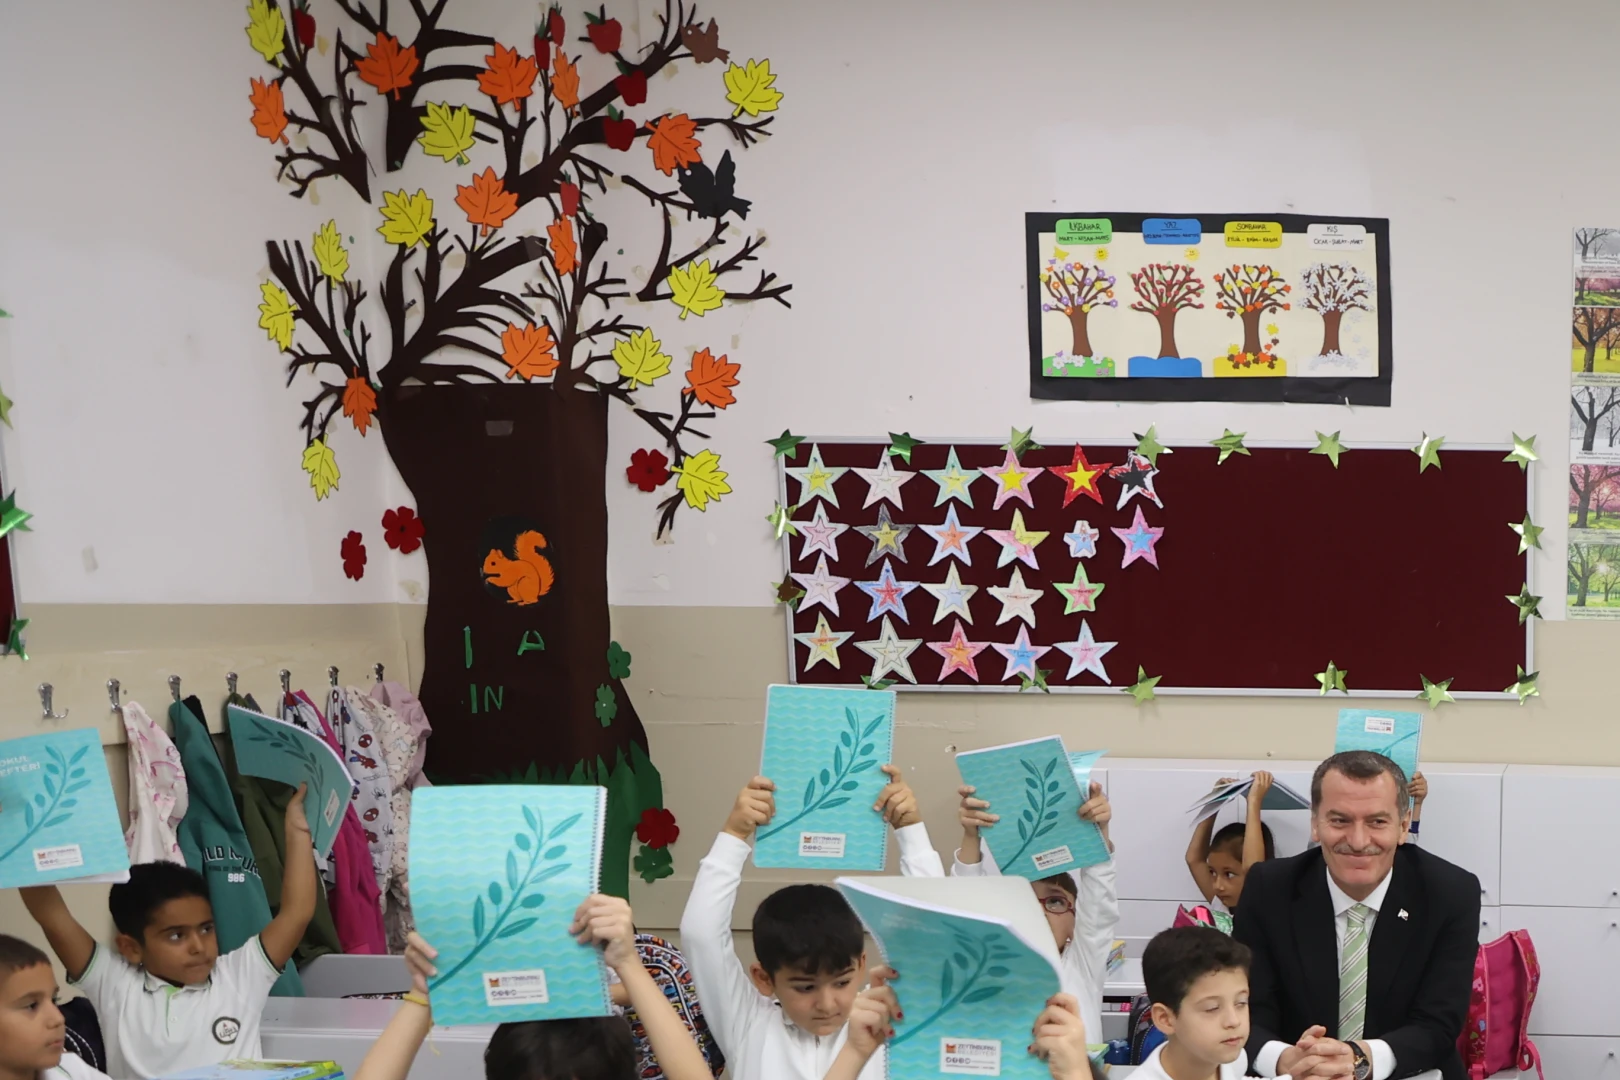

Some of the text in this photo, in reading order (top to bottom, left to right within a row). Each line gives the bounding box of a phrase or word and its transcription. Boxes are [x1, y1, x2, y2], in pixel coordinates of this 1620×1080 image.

[1326, 226, 1338, 234] KIŞ
[516, 629, 545, 656] A
[0, 762, 40, 777] EFTERİ
[227, 872, 245, 883] 986
